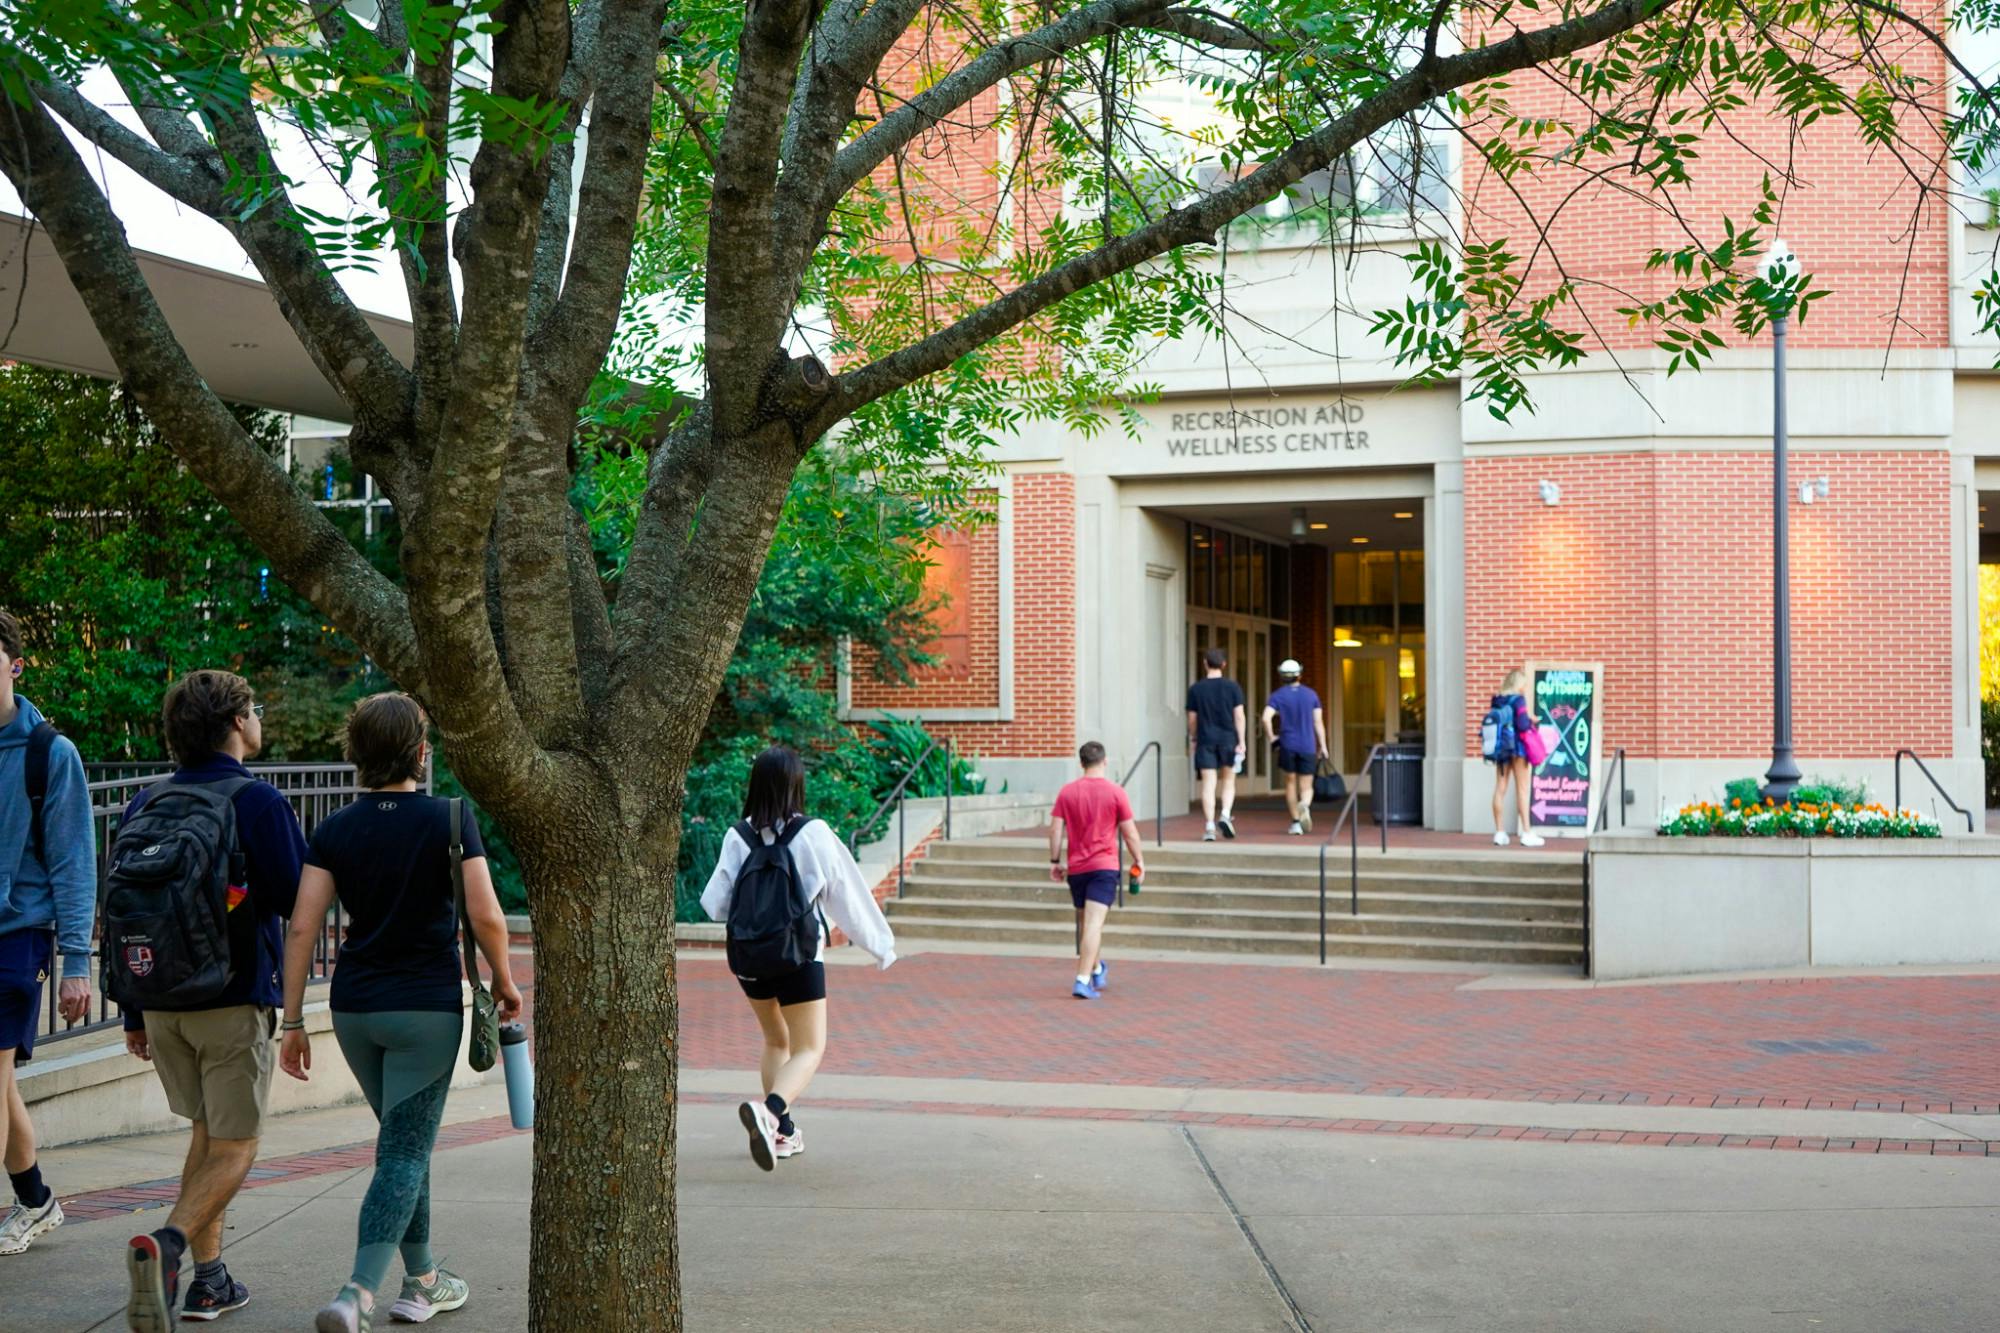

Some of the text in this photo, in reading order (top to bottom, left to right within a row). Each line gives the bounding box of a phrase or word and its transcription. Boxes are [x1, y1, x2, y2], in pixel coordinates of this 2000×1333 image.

[1171, 404, 1365, 432] RECREATION AND
[1167, 431, 1370, 457] WELLNESS CENTER
[1536, 681, 1593, 696] OUTDOORS
